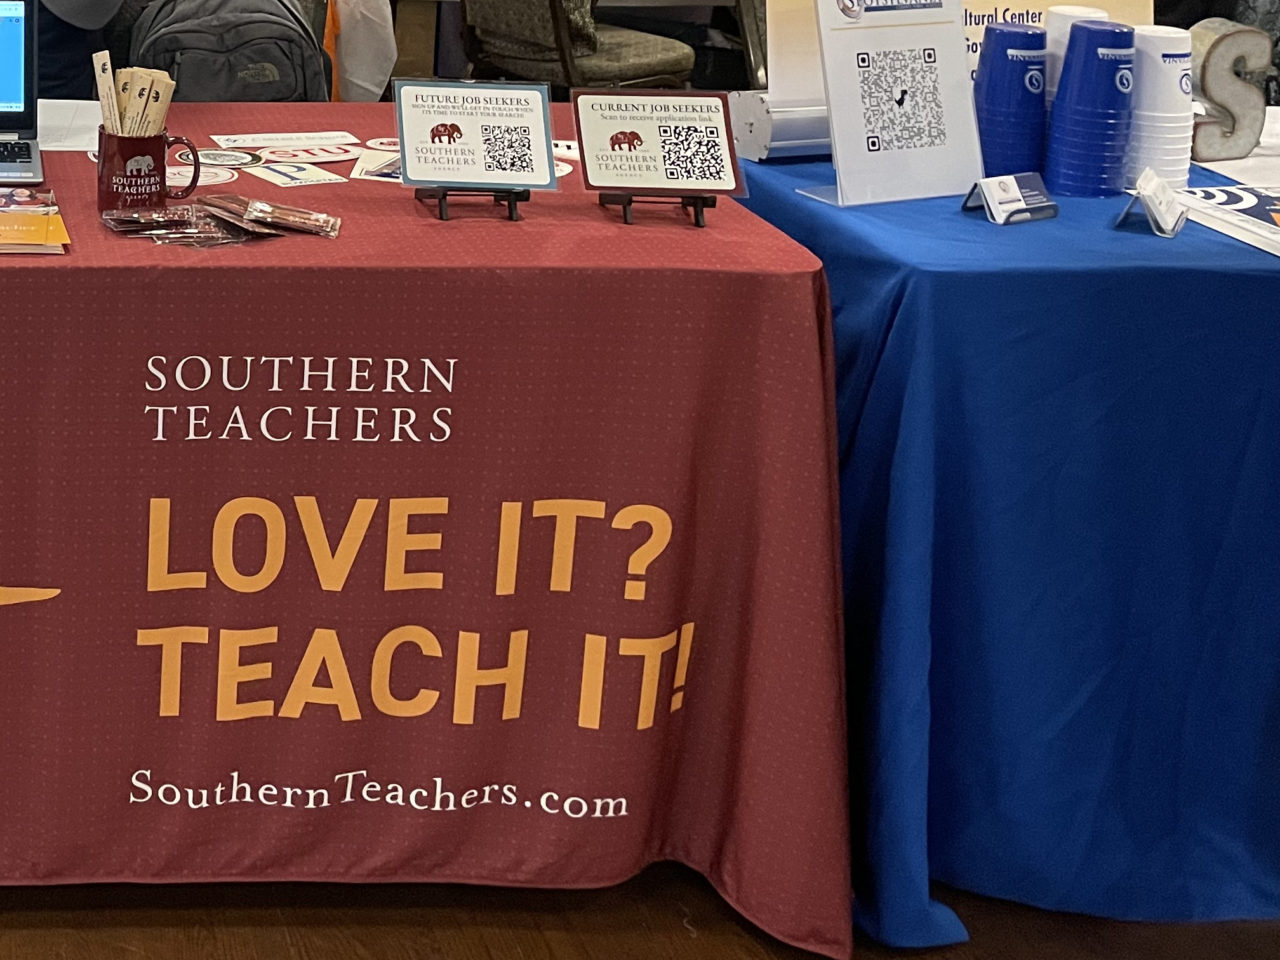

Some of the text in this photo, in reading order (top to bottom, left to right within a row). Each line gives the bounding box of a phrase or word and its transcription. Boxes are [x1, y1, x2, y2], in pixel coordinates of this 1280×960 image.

[415, 94, 530, 106] FUTURE JOB SEEKERS
[591, 103, 720, 114] CURRENT JOB SEEKERS
[600, 113, 618, 121] Scan
[620, 113, 627, 121] to
[656, 114, 697, 124] application
[699, 114, 712, 122] link
[269, 147, 351, 158] STU
[415, 146, 476, 156] SOUTHERN
[416, 156, 476, 166] TEACHERS
[595, 154, 657, 163] SOUTHERN
[597, 163, 659, 172] TEACHERS
[112, 176, 160, 186] SOUTHERN
[112, 184, 161, 194] TEACHERS
[144, 355, 458, 393] SOUTHERN
[144, 405, 453, 442] TEACHERS
[146, 496, 673, 601] LOVE IT?
[136, 622, 695, 730] TEACH IT!
[129, 769, 628, 818] SouthernTeachers.com
